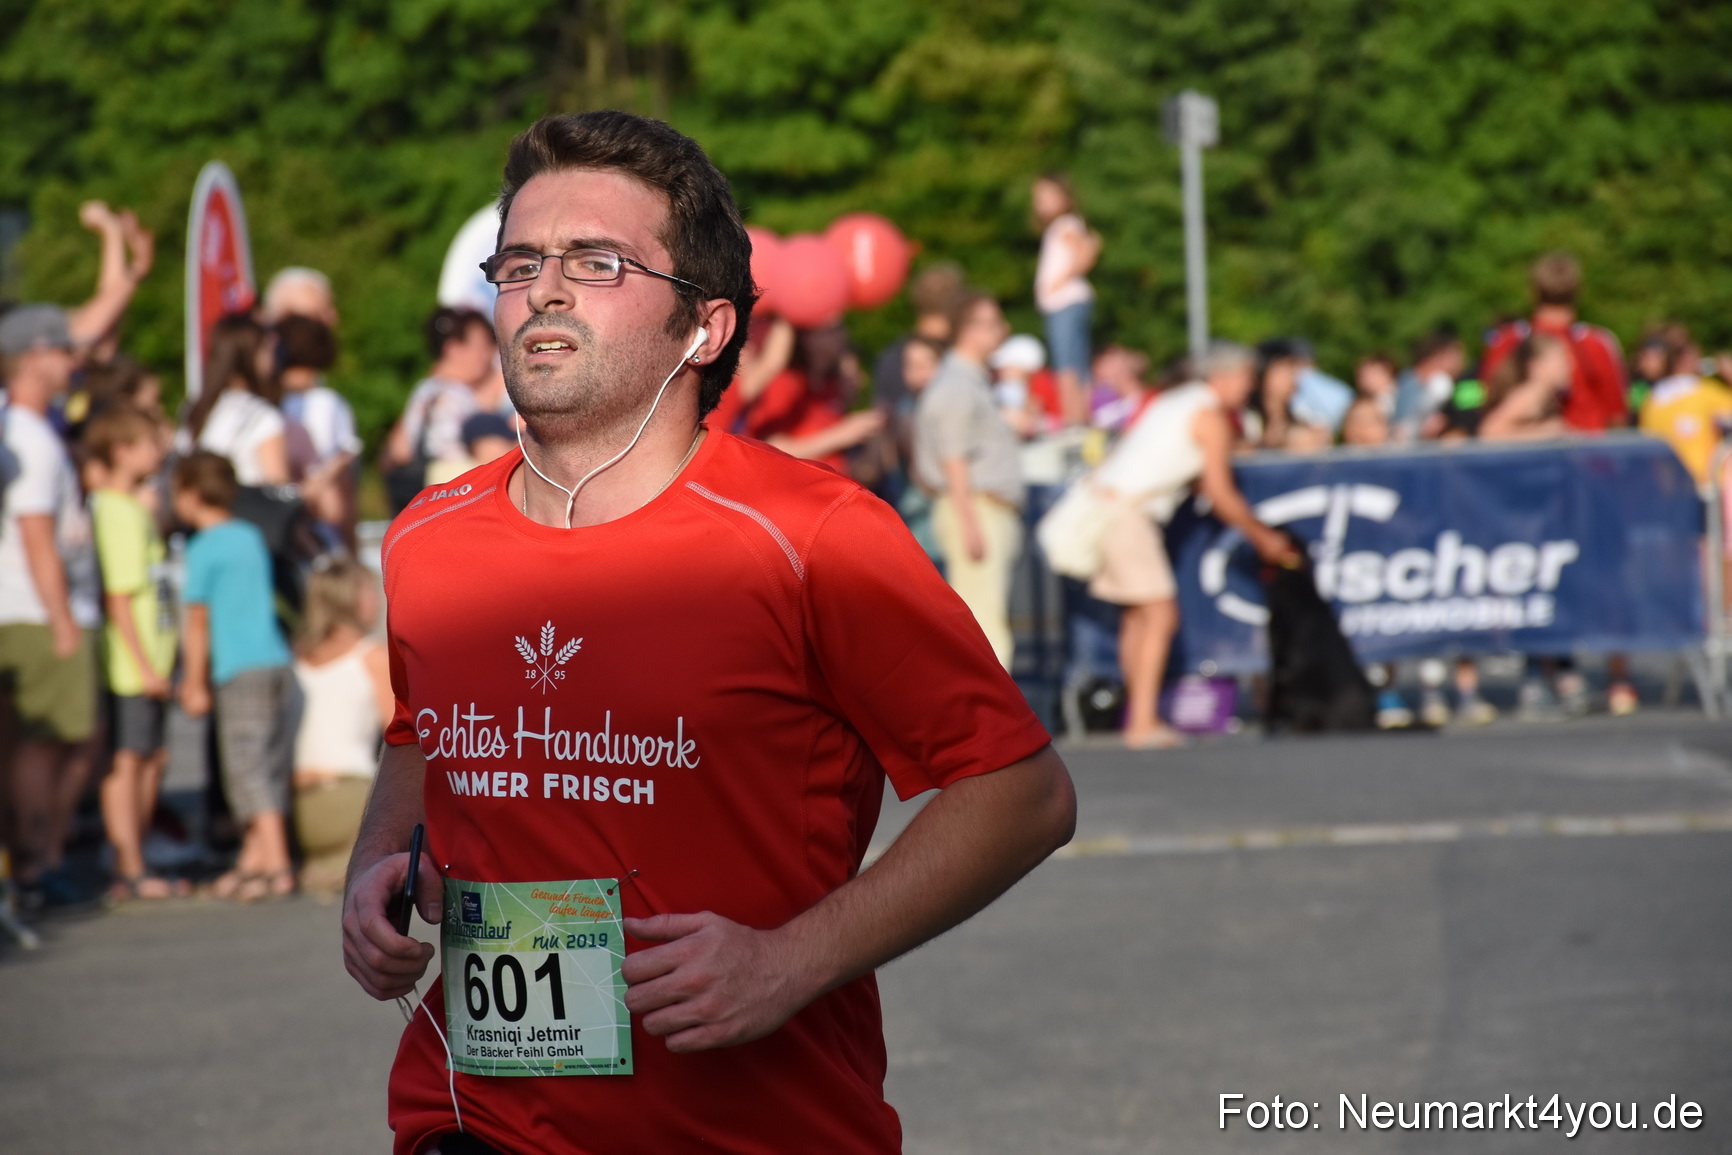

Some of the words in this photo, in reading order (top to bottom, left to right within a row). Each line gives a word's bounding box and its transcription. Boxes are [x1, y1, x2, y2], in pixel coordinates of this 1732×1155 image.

[428, 483, 473, 502] JAKO
[1308, 527, 1579, 603] ischer
[524, 669, 537, 679] 18
[554, 669, 566, 680] 95
[416, 702, 510, 761] Echtes
[513, 706, 701, 770] Handwerk
[446, 770, 529, 799] IMMER
[543, 772, 655, 805] FRISCH
[531, 888, 571, 902] Gesunde
[573, 892, 605, 906] Firmen
[549, 903, 578, 917] laufen
[532, 935, 559, 950] run
[566, 932, 608, 948] 2019
[464, 953, 566, 1023] 601
[467, 1024, 522, 1047] Krasniqi
[527, 1025, 581, 1042] Jetmir
[467, 1045, 479, 1057] Der
[481, 1046, 513, 1058] Bäcker
[517, 1046, 544, 1058] Feihl
[547, 1045, 584, 1057] GmbH
